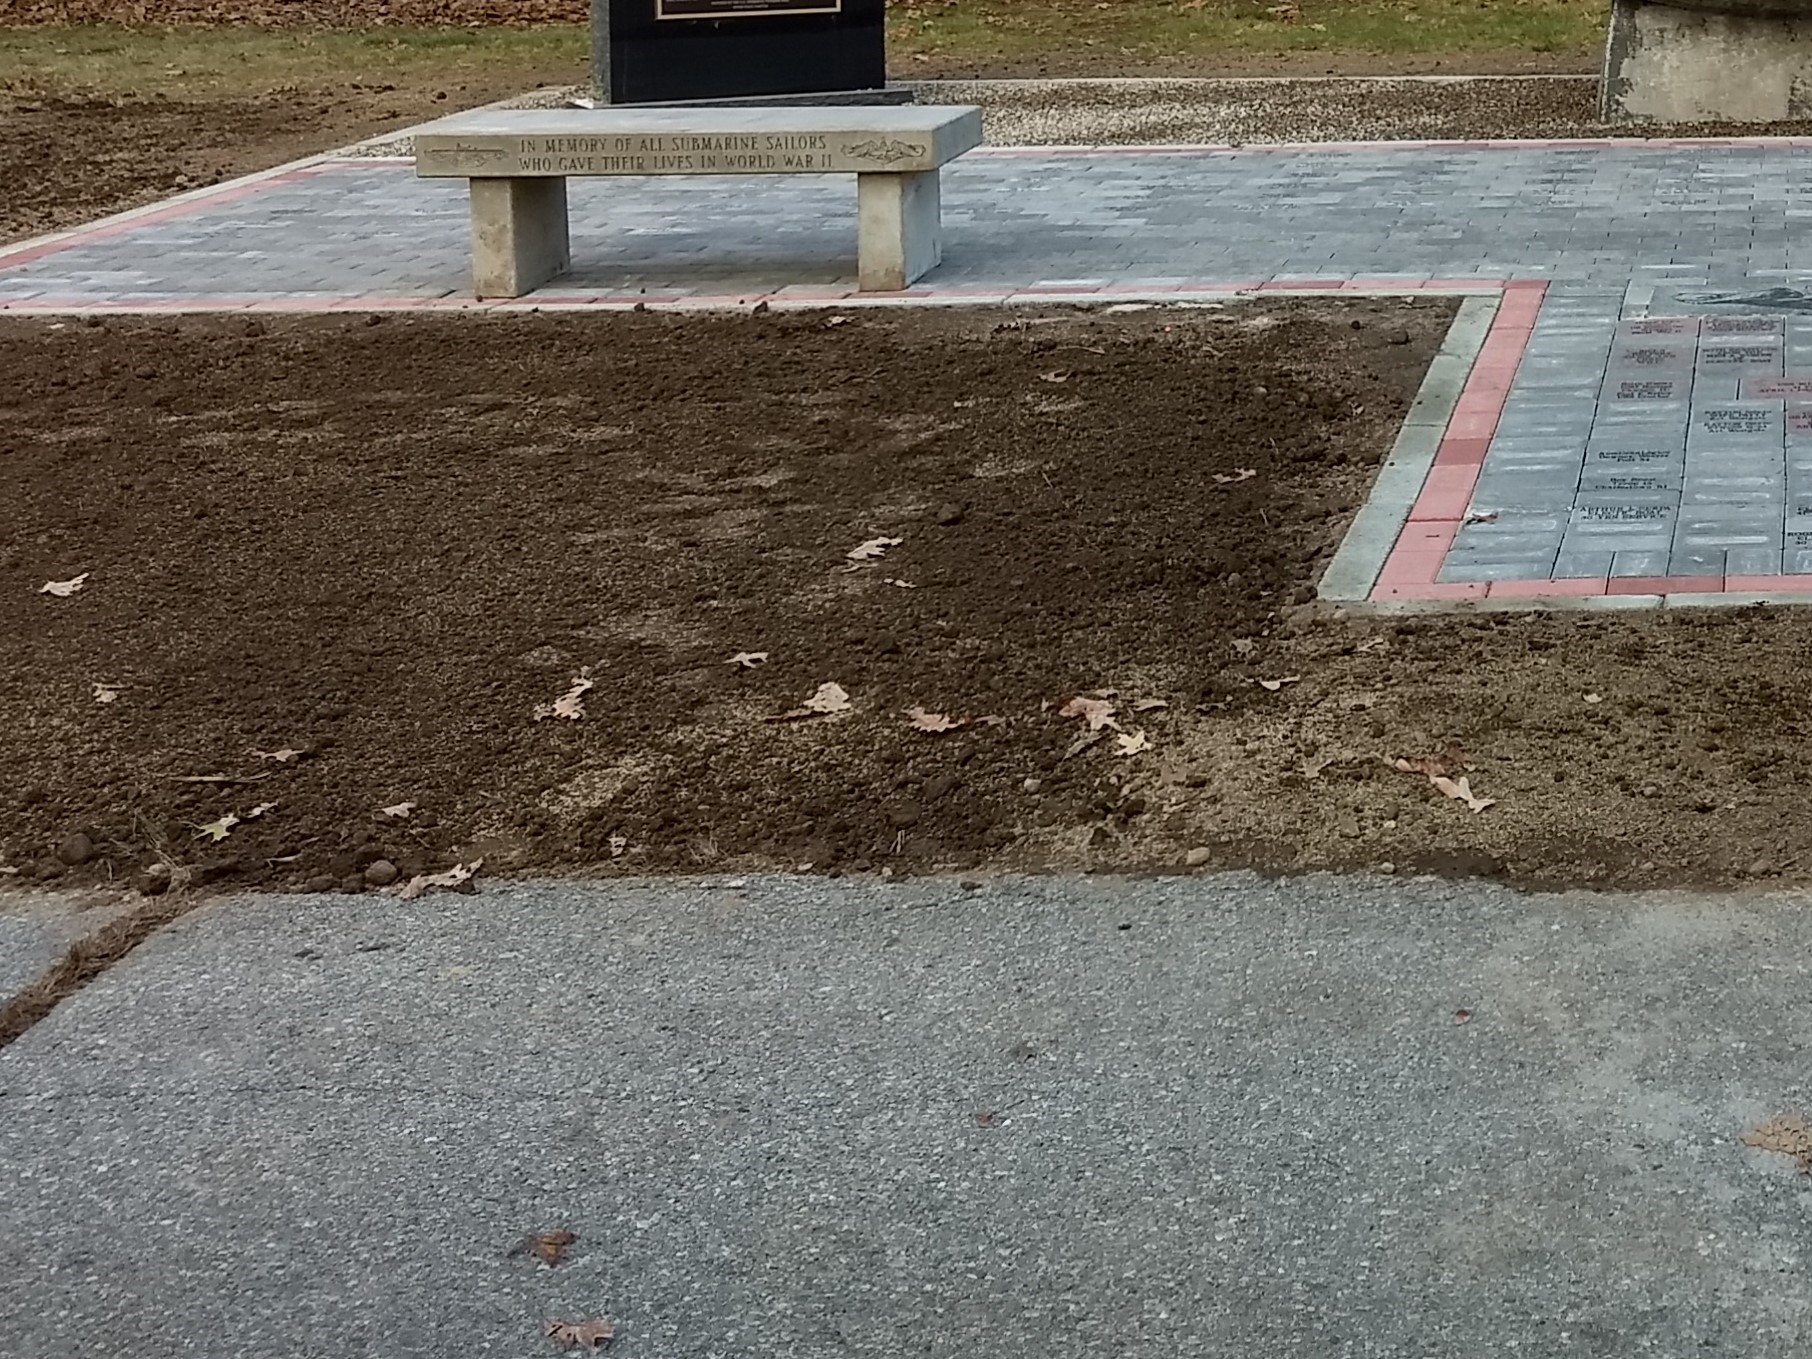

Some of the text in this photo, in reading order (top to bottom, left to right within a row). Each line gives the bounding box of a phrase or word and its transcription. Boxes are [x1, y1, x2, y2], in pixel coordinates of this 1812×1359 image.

[519, 135, 827, 153] IN MEMORY OF ALL SUBMARINE SAILORS
[518, 154, 833, 171] WHO GAVE THEIR LIVES IN WORLD WAR II
